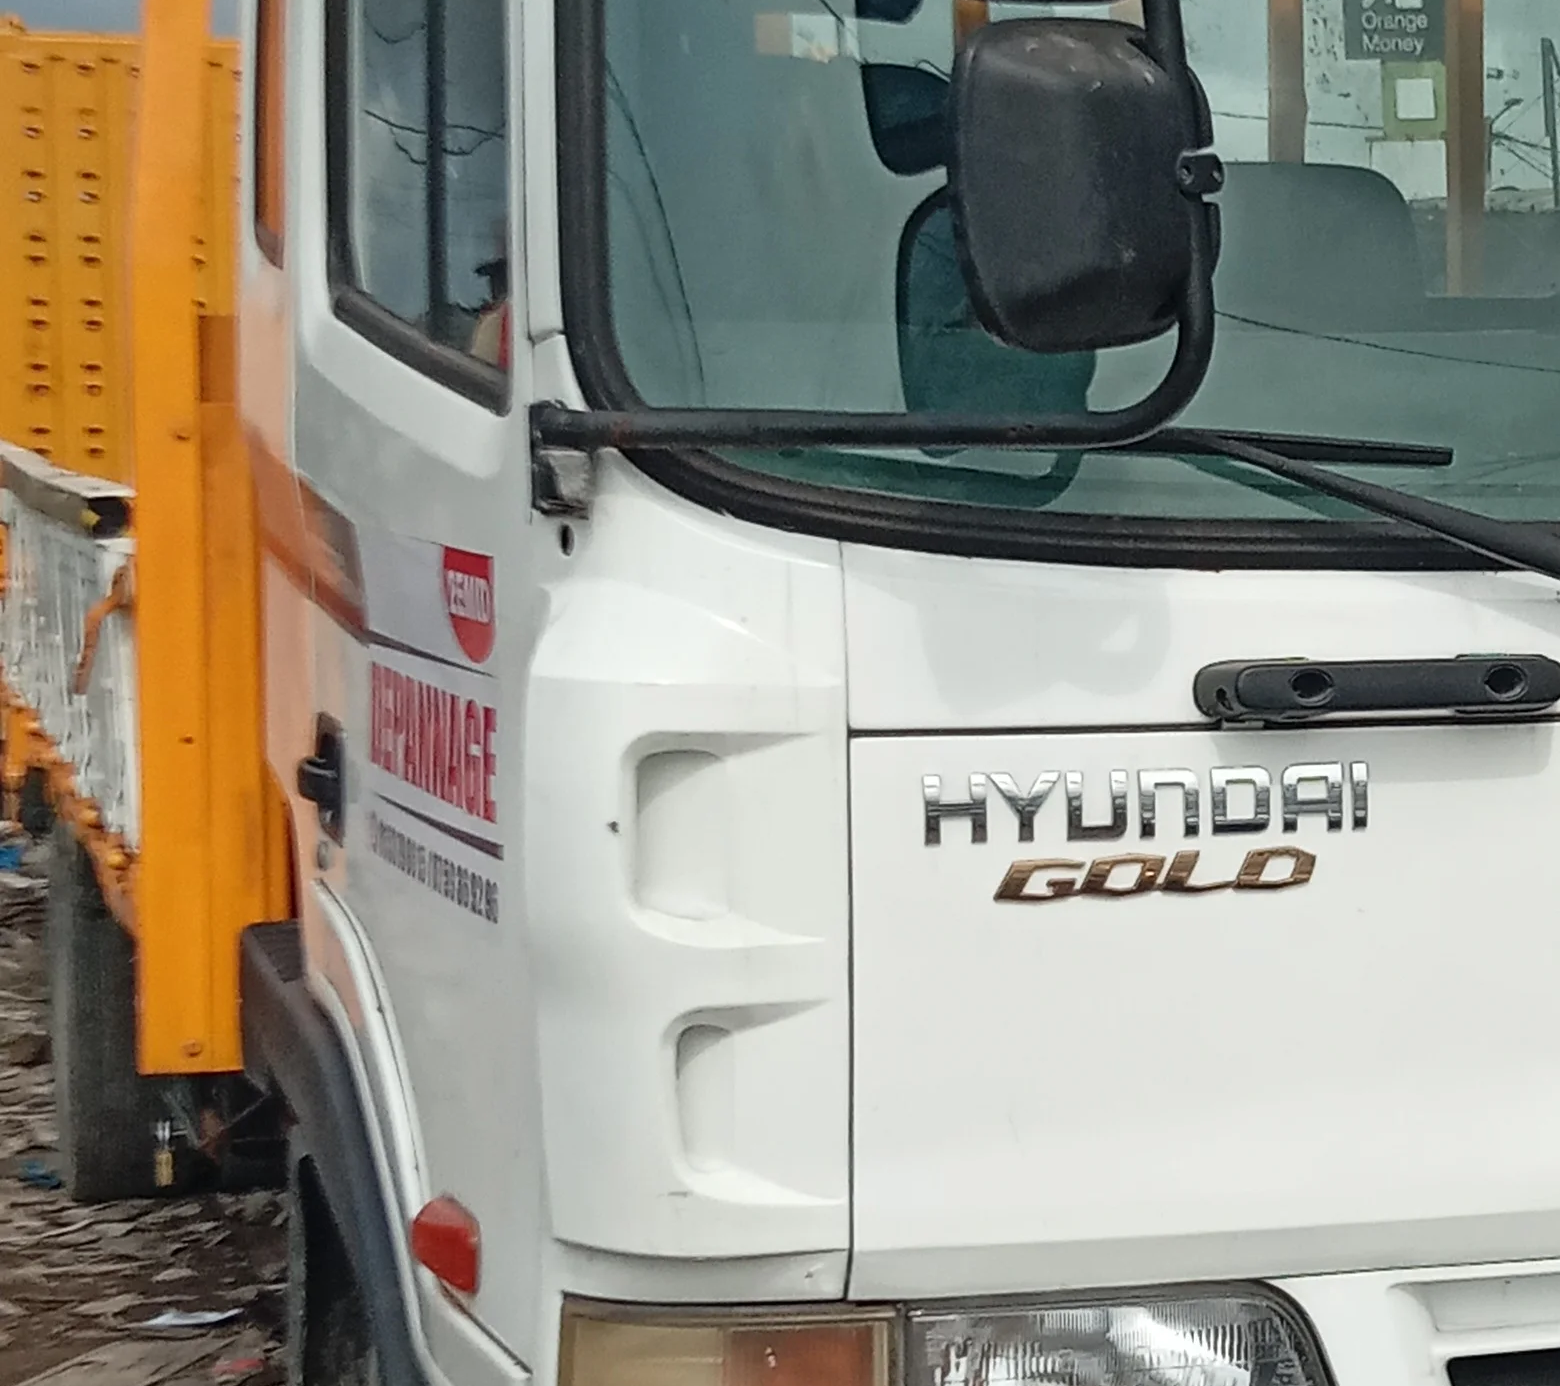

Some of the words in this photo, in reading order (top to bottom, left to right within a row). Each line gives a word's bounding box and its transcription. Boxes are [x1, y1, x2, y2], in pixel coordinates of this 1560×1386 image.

[1361, 11, 1428, 33] Orange
[1362, 33, 1425, 55] Money
[371, 661, 498, 824] DEPANNAGE
[921, 760, 1370, 846] HYUNDAI
[993, 845, 1317, 902] GOLD
